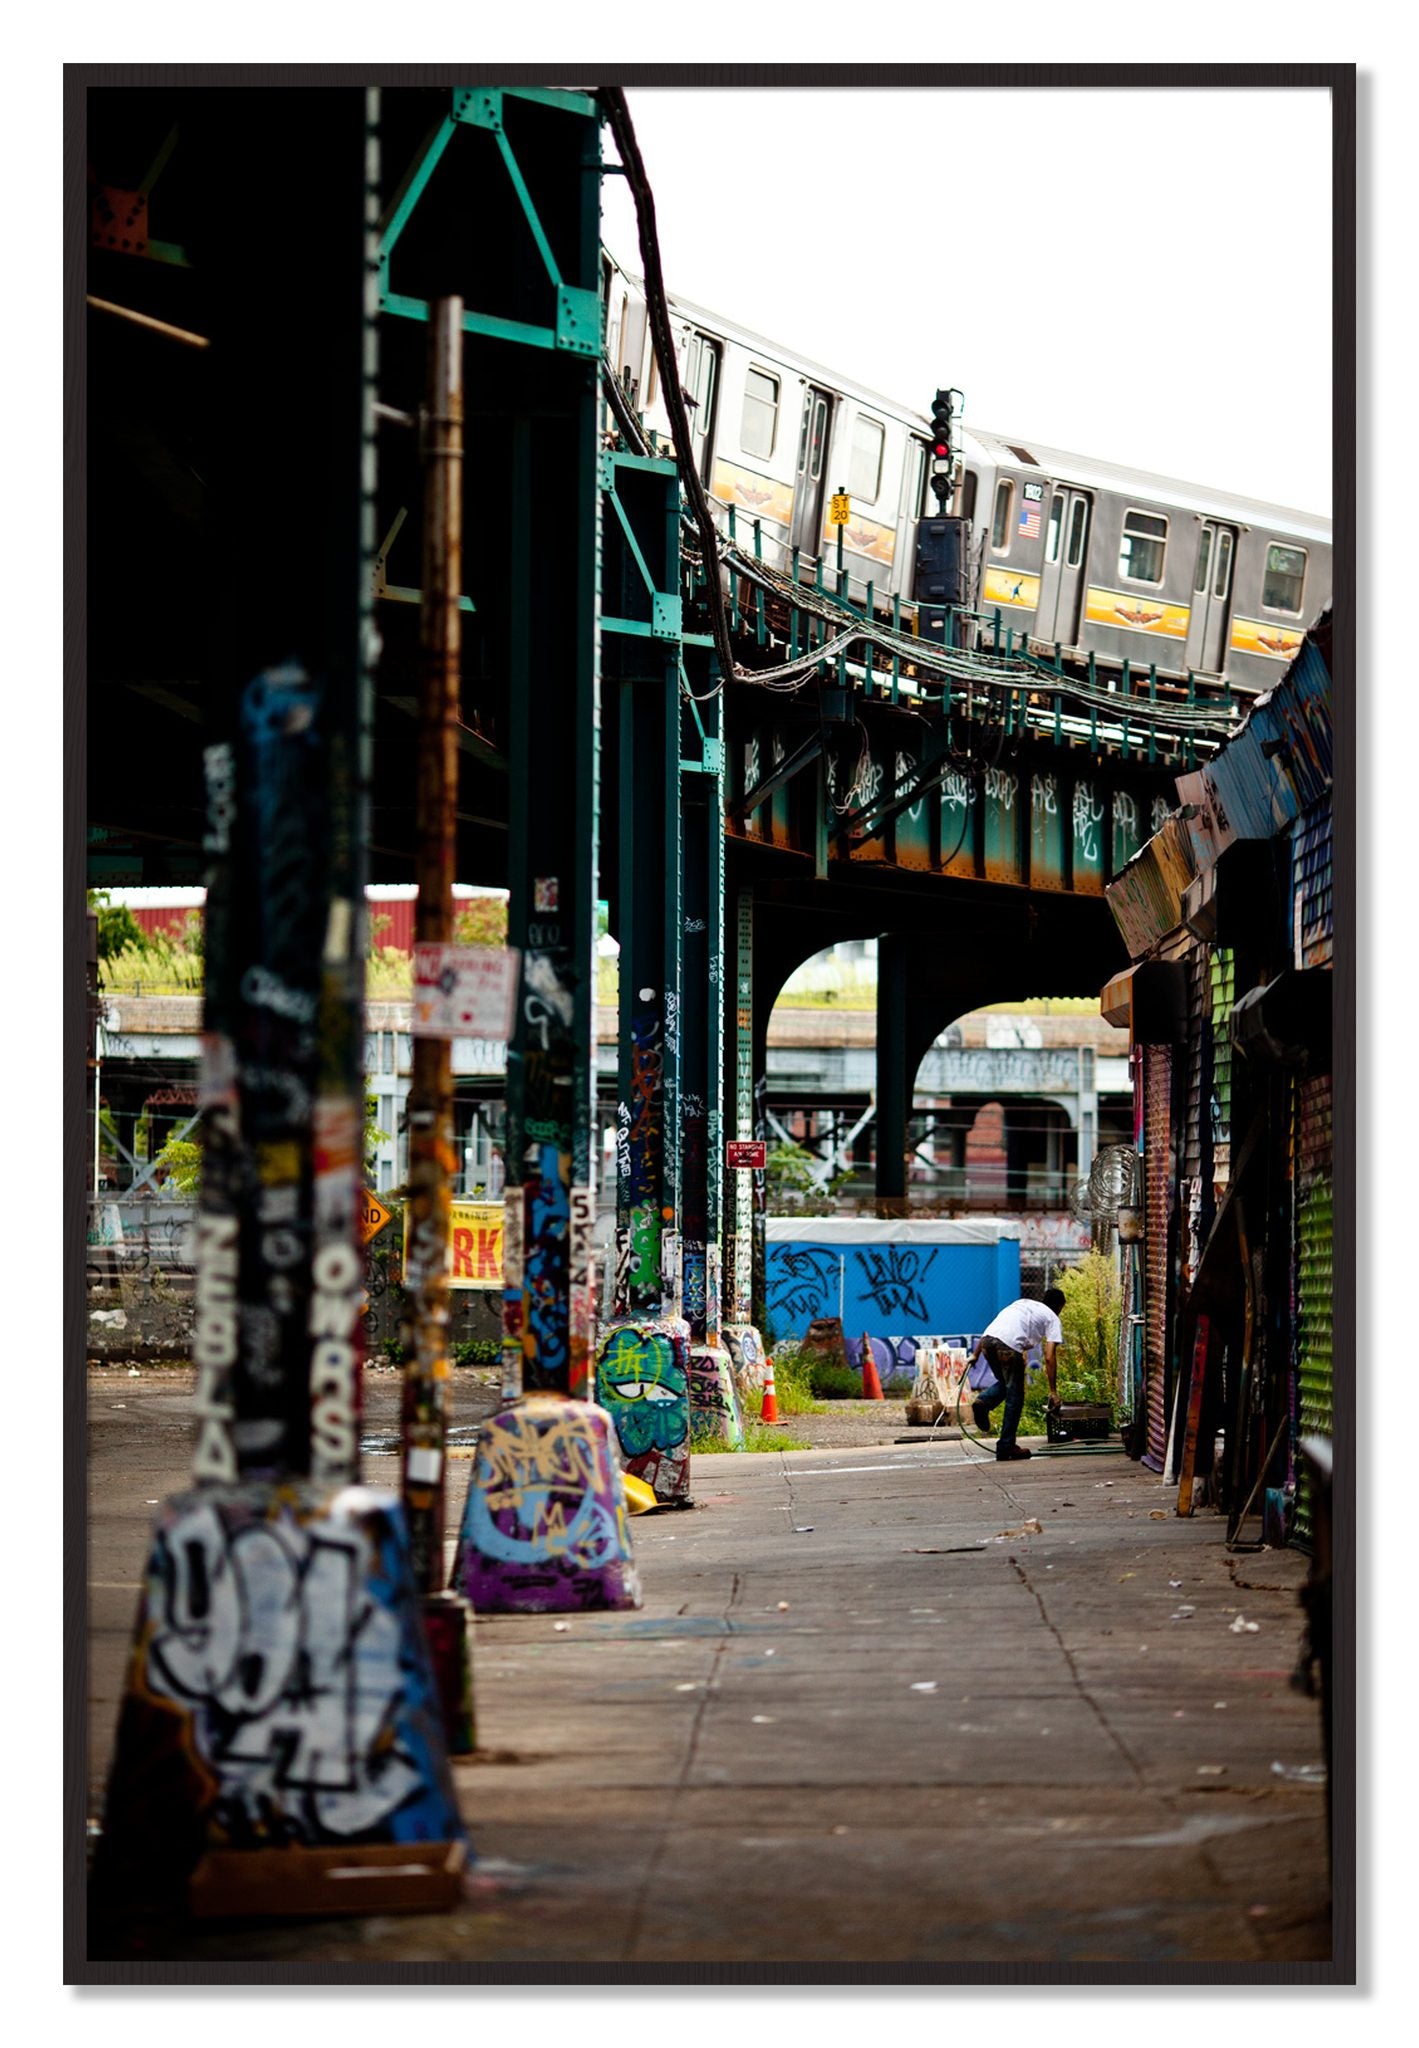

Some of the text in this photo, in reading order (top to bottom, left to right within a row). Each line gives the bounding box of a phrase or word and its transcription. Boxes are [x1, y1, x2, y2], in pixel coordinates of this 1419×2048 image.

[834, 510, 848, 520] 20
[738, 1143, 764, 1151] STANG
[361, 1209, 381, 1224] ND
[452, 1210, 489, 1221] ARKING
[453, 1227, 500, 1278] RK
